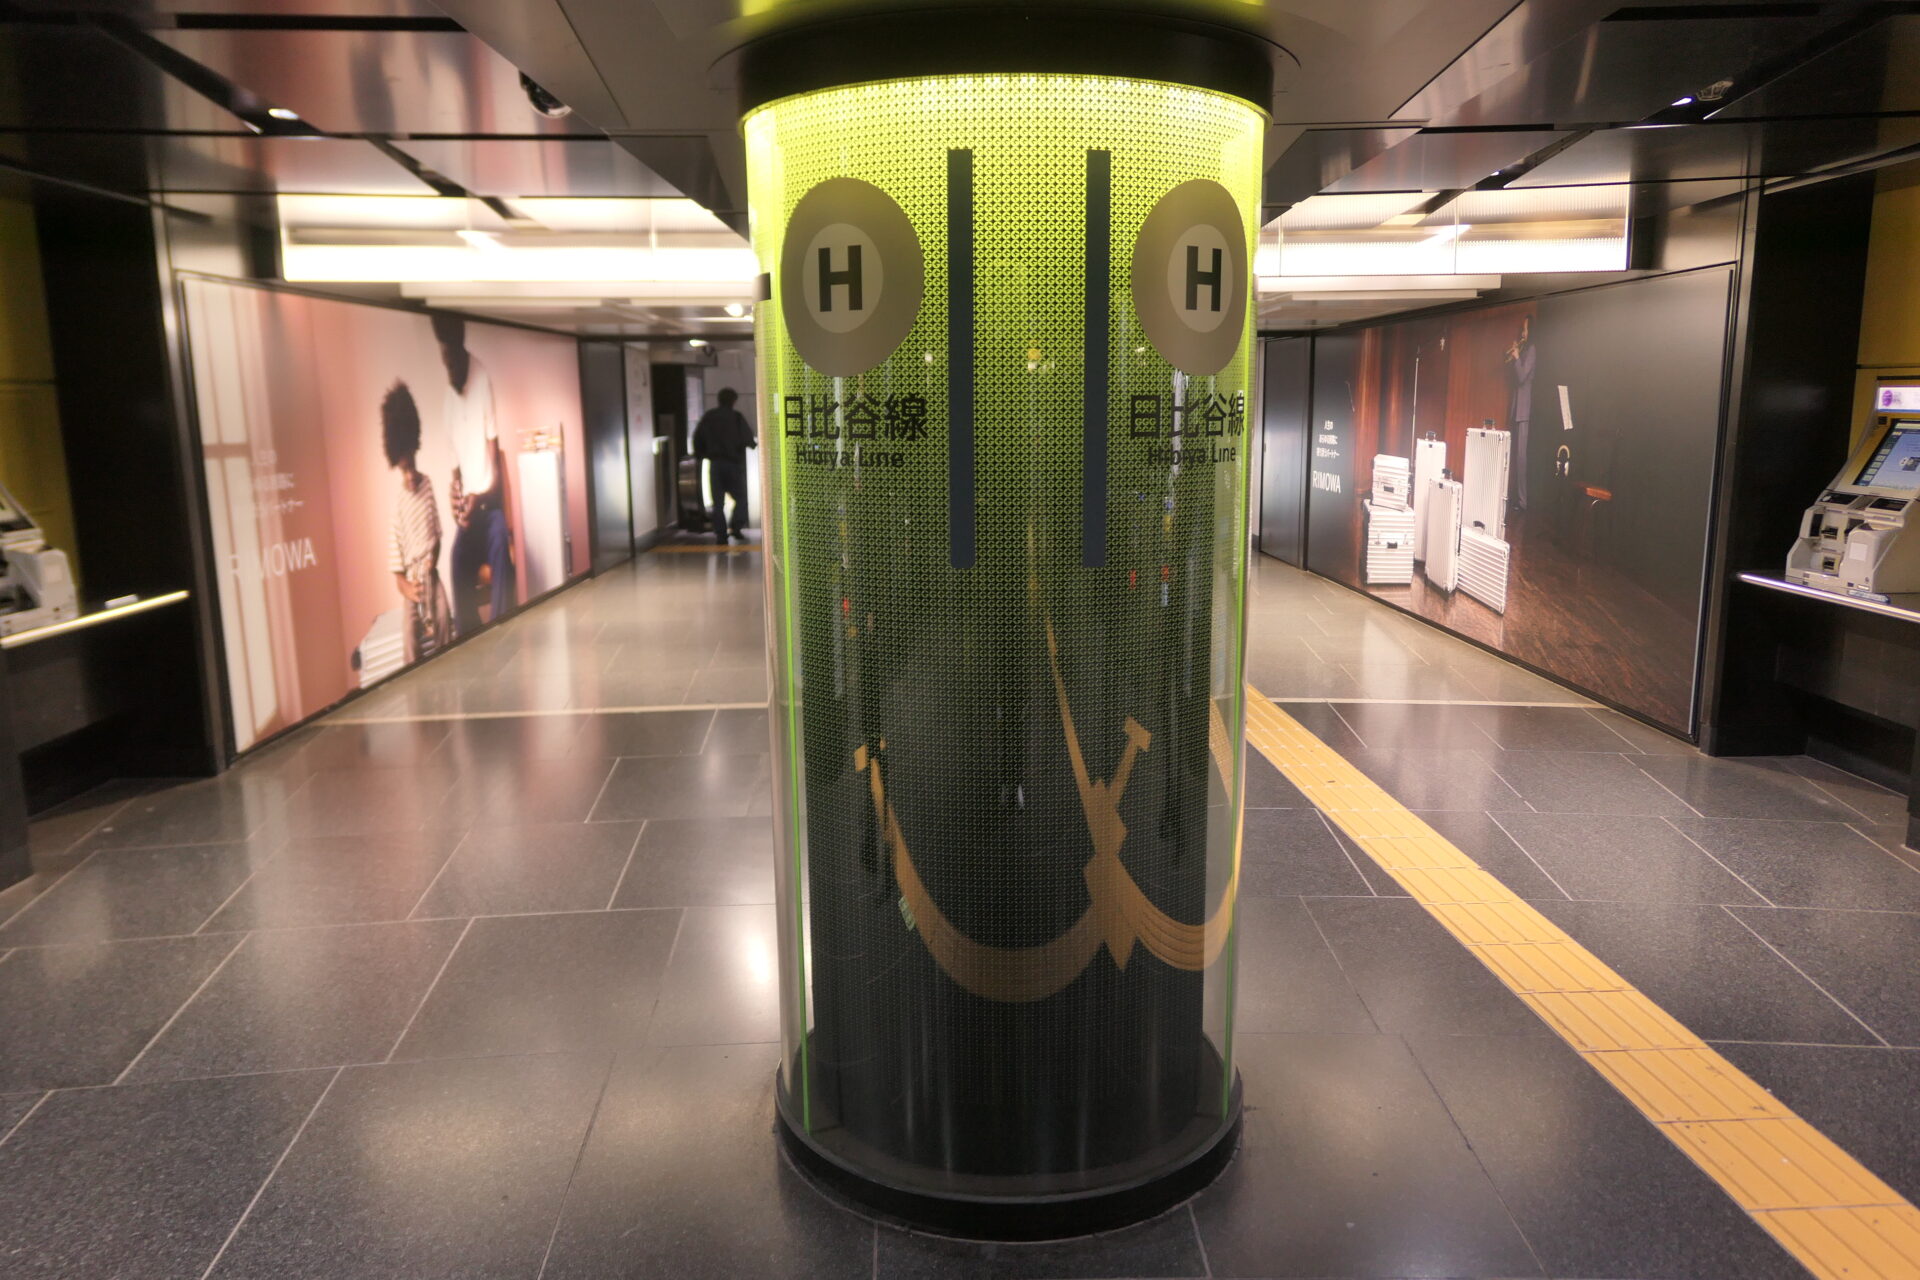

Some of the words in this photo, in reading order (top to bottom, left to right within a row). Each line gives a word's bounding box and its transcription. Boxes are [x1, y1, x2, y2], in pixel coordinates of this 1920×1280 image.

[818, 245, 863, 312] H
[1185, 245, 1222, 312] H
[784, 393, 929, 442] 日比谷線
[1130, 392, 1245, 440] 日比谷線
[796, 443, 851, 471] Hibiya
[858, 446, 903, 467] Line
[1148, 443, 1208, 470] Hibiya
[1211, 439, 1237, 463] Line
[1312, 470, 1341, 494] RIMOWA
